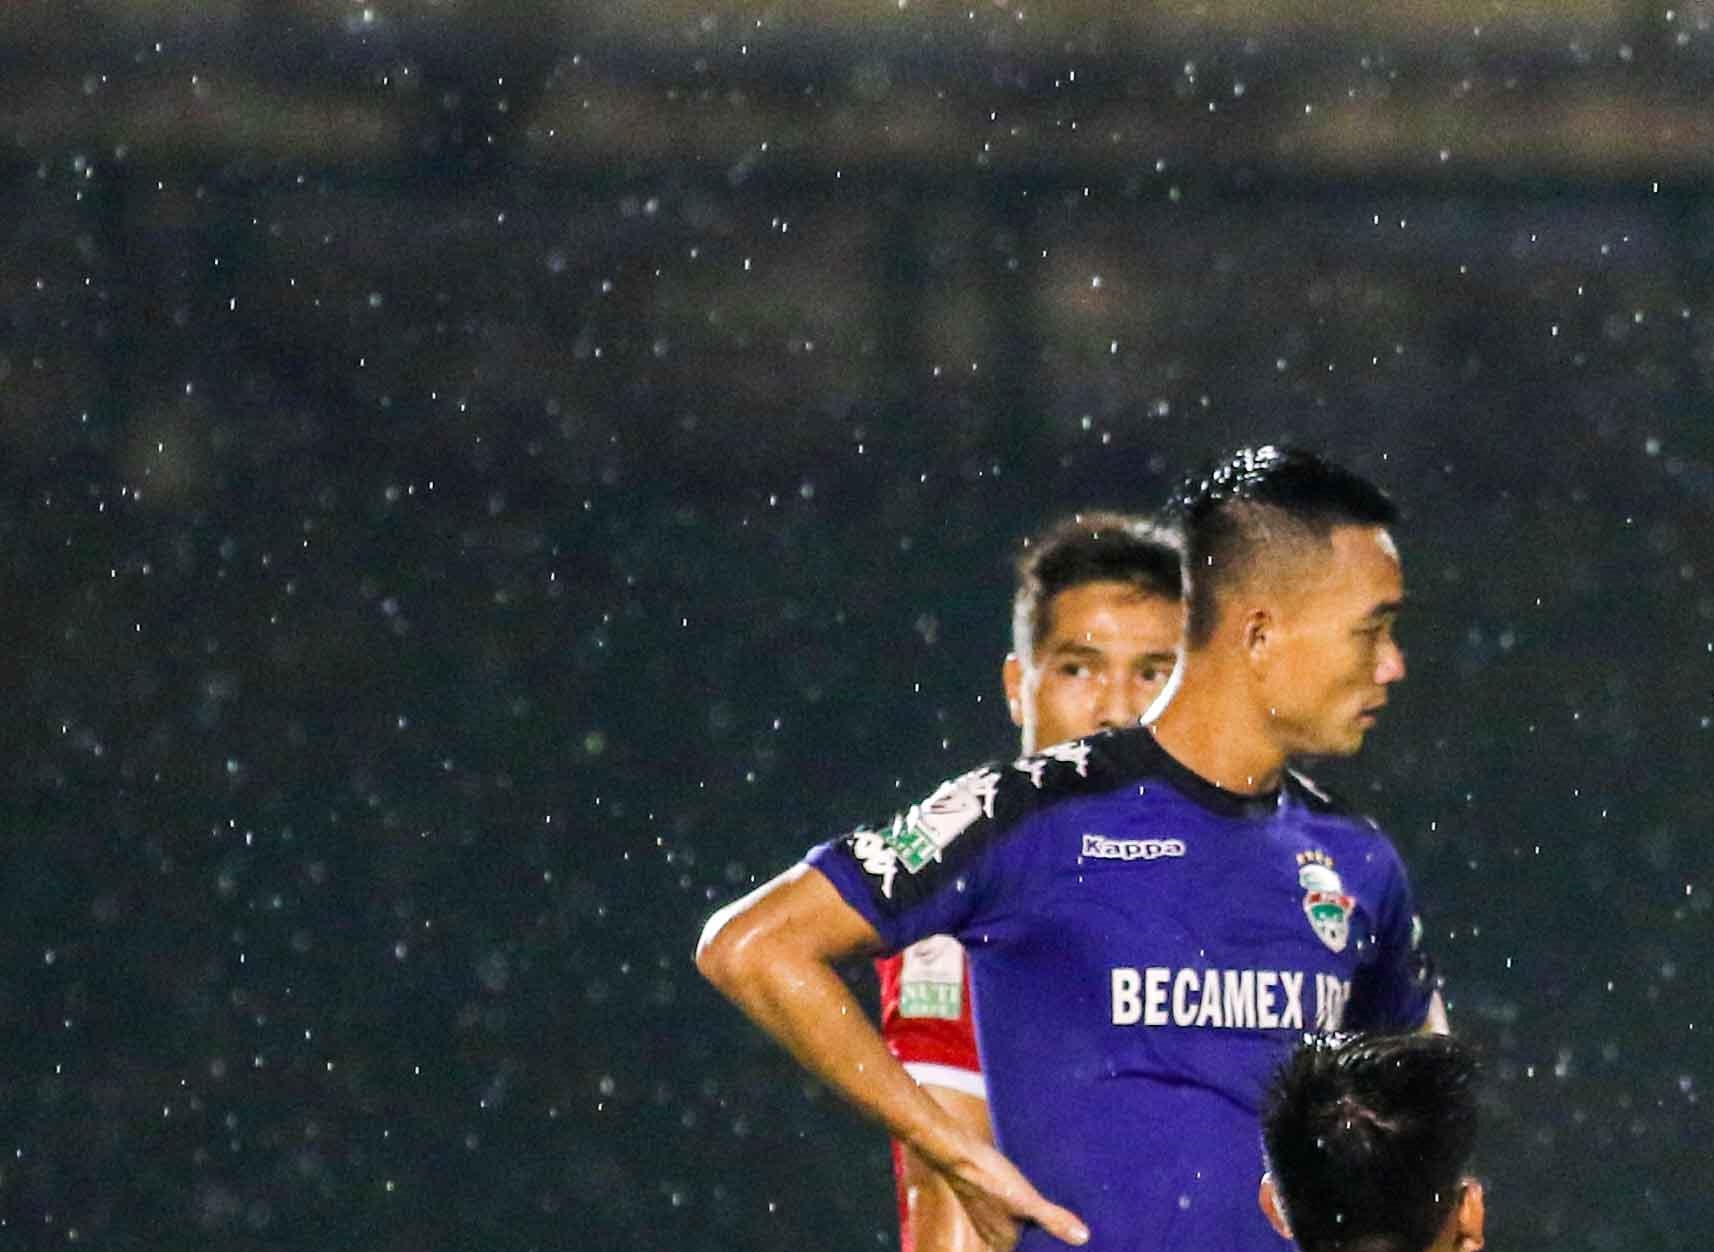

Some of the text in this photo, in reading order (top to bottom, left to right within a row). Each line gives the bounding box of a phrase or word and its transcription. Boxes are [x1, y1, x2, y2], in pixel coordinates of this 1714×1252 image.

[1082, 835, 1185, 860] Kappa
[1111, 967, 1351, 1031] BECAMEX ID
